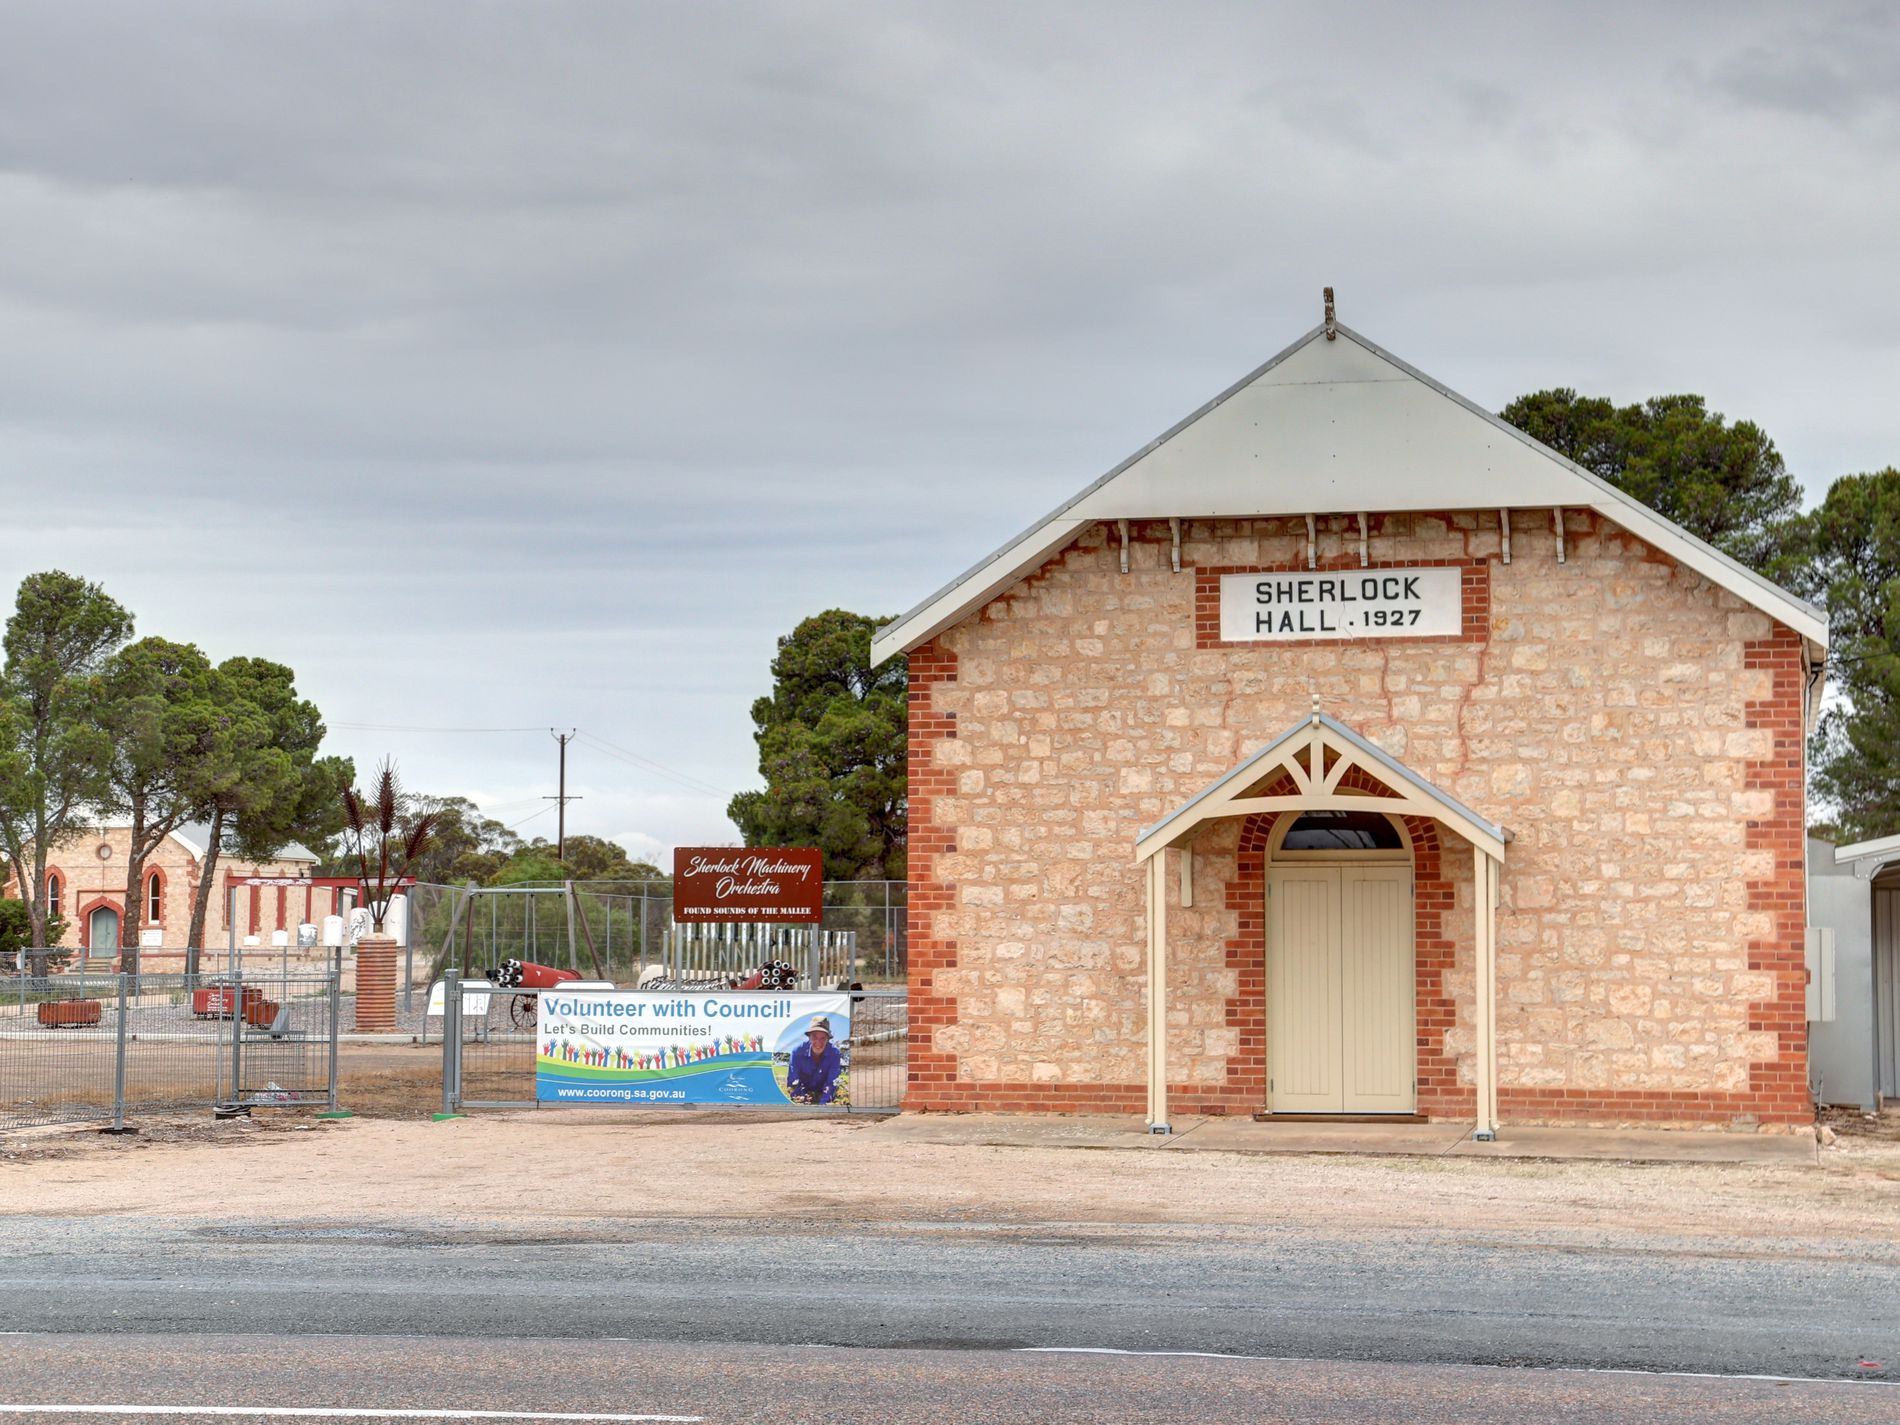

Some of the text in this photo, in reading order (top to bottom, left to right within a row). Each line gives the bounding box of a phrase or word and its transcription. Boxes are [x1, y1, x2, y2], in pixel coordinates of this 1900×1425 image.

[1256, 577, 1421, 604] SHERLOCK
[1256, 610, 1336, 633] HALL
[684, 856, 811, 881] Sherlock Machinery
[716, 876, 781, 899] Orchestra
[684, 907, 811, 915] FOUND SOUNDS OF THE MALLEE
[544, 998, 791, 1018] Volunteer with Council!
[544, 1023, 711, 1036] Let's Build Communities!
[558, 1087, 686, 1100] www.coorong.sa.gov.au
